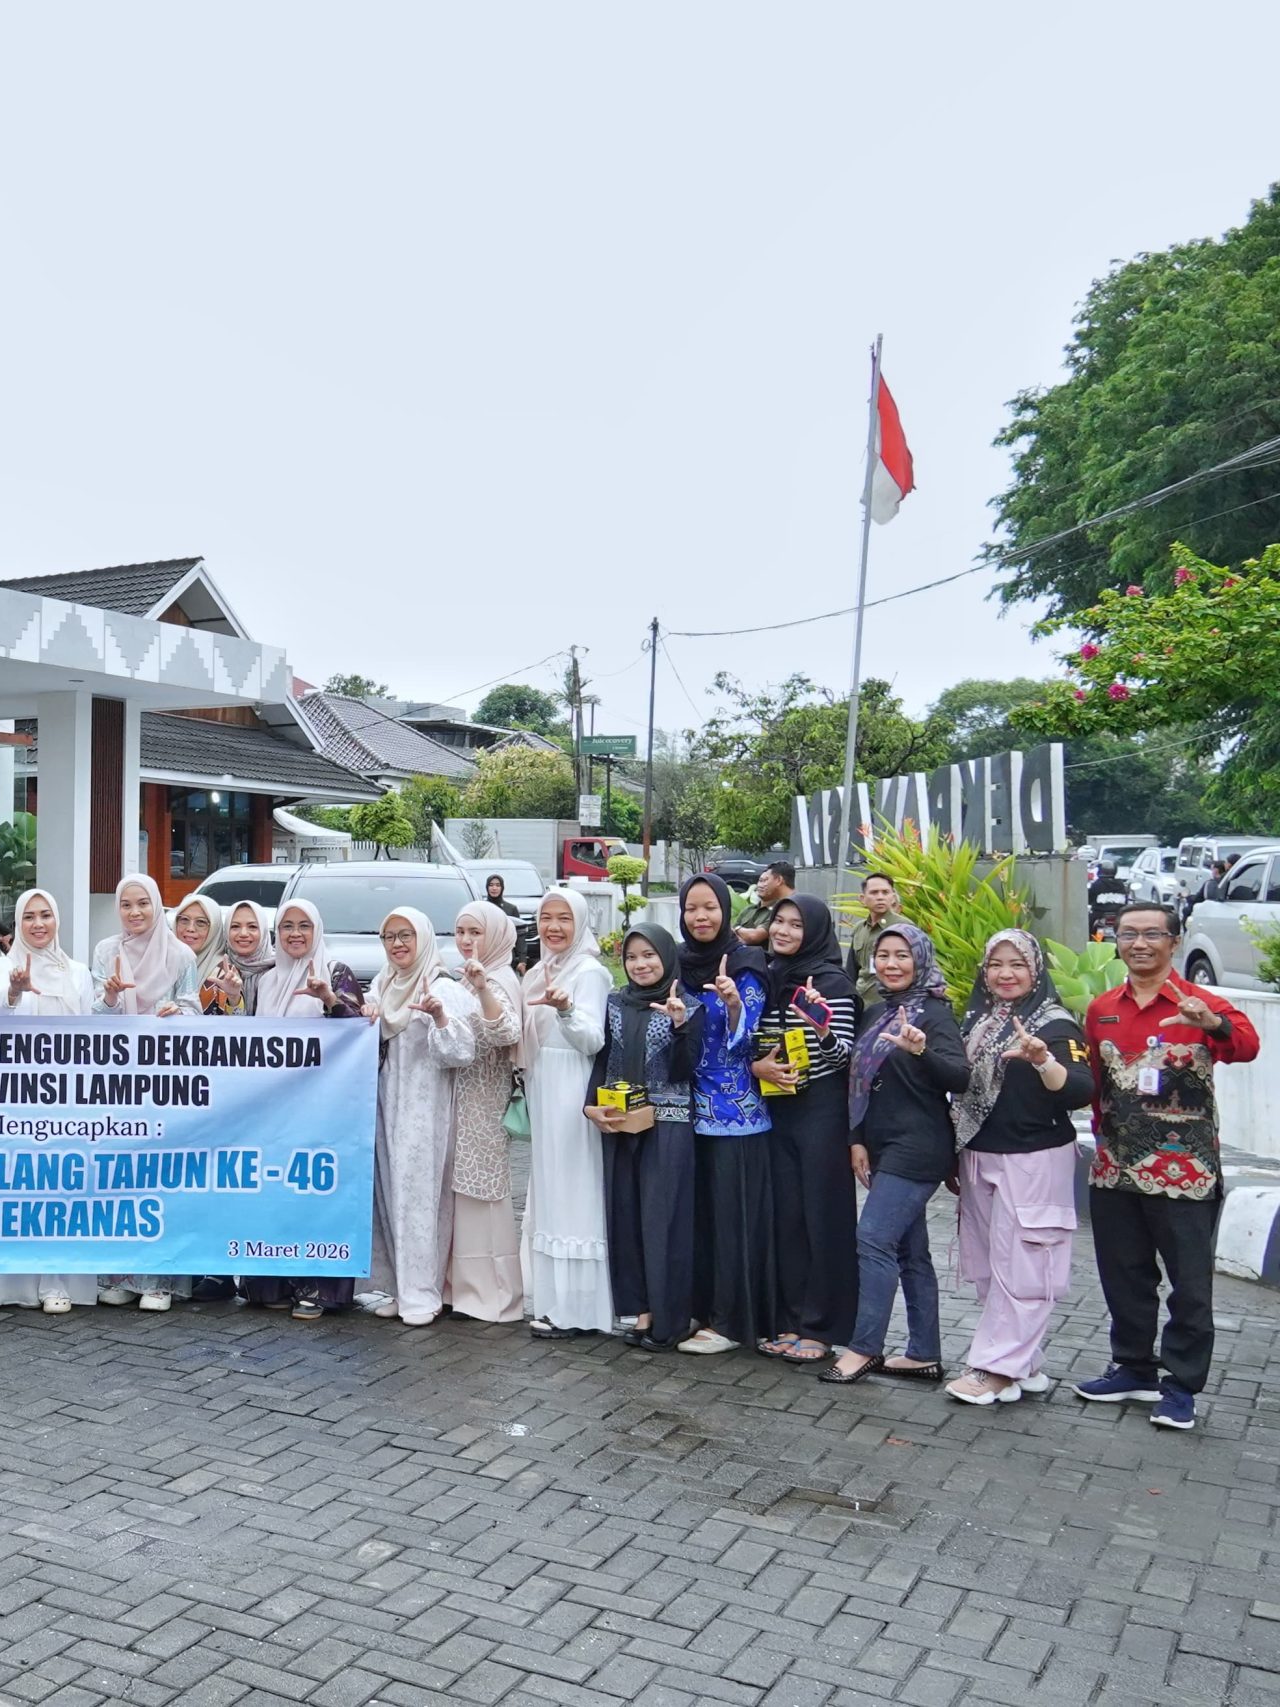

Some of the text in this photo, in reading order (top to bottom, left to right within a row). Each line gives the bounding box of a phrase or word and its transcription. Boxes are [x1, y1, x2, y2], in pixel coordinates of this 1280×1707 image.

[137, 1035, 322, 1068] DEKRANASDA
[75, 1074, 210, 1106] LAMPUNG
[95, 1151, 207, 1190] TAHUN
[216, 1151, 258, 1189] KE
[287, 1152, 335, 1191] 46
[228, 1241, 350, 1259] 3 Maret 2026
